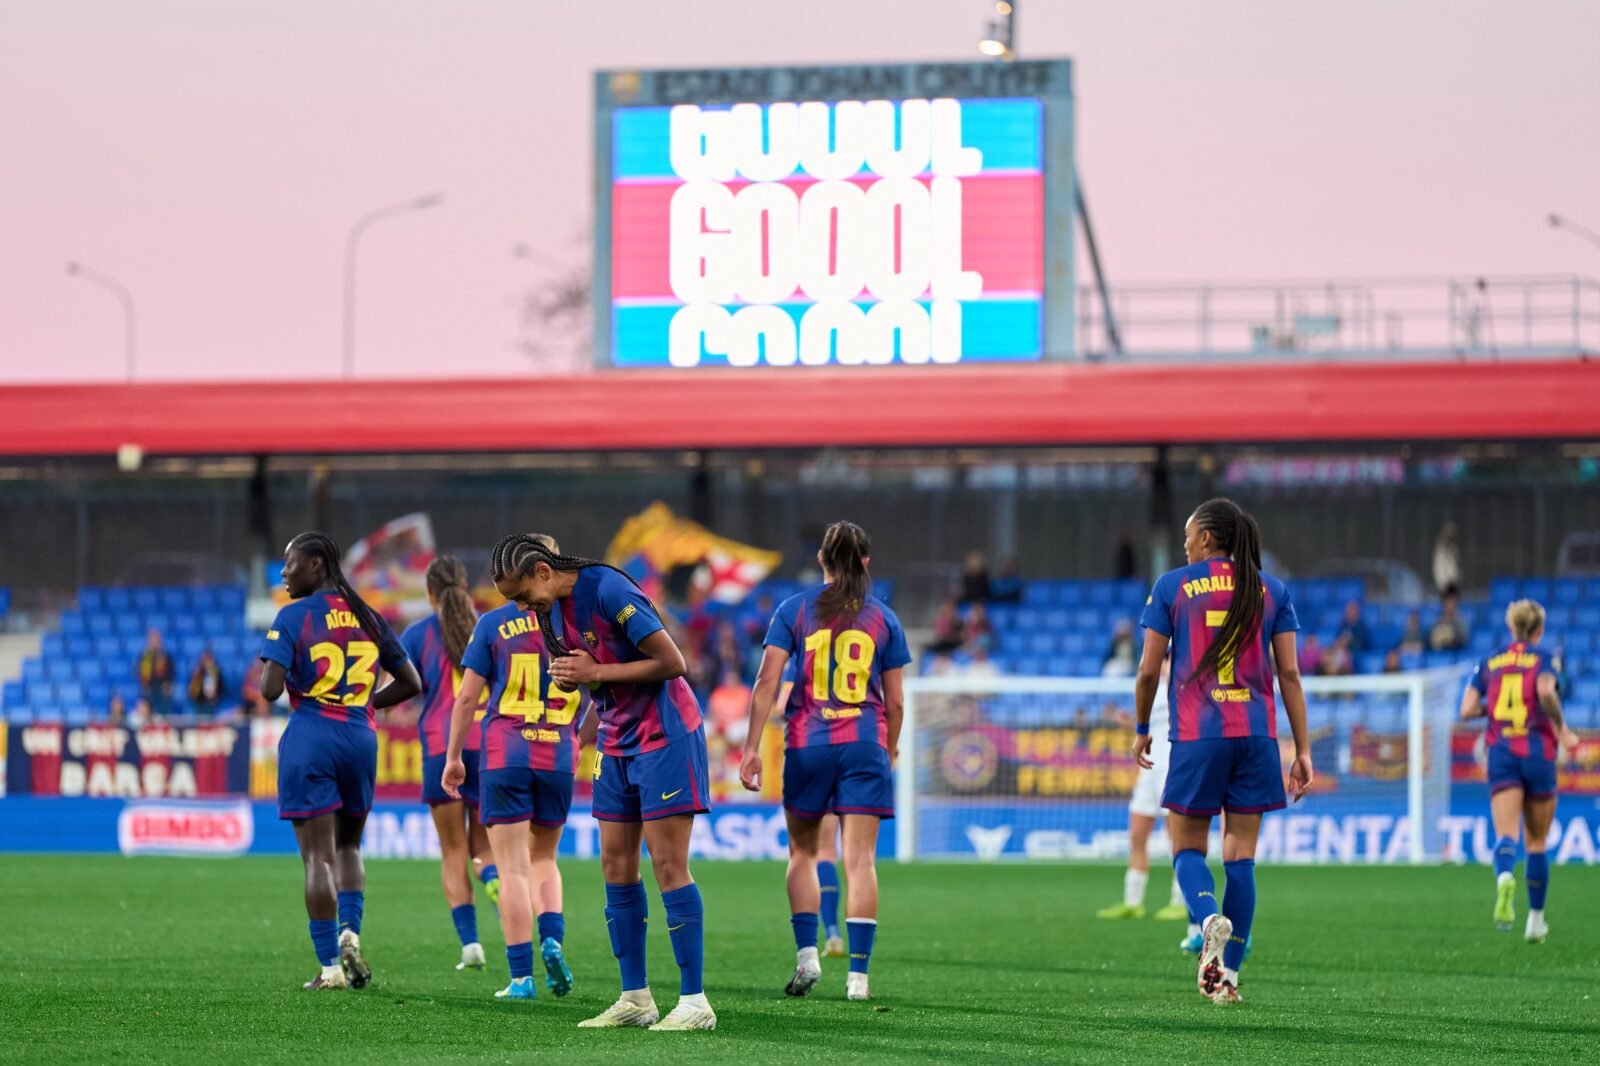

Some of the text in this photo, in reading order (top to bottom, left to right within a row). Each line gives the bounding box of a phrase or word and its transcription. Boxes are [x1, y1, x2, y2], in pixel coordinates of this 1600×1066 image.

[669, 176, 983, 305] GOOOL
[1182, 575, 1266, 599] PARALL
[498, 615, 541, 640] CARL
[303, 641, 379, 706] 23
[804, 629, 875, 704] 18
[1493, 673, 1528, 731] 4
[131, 811, 243, 845] BIMBO
[1252, 814, 1414, 864] MENTA
